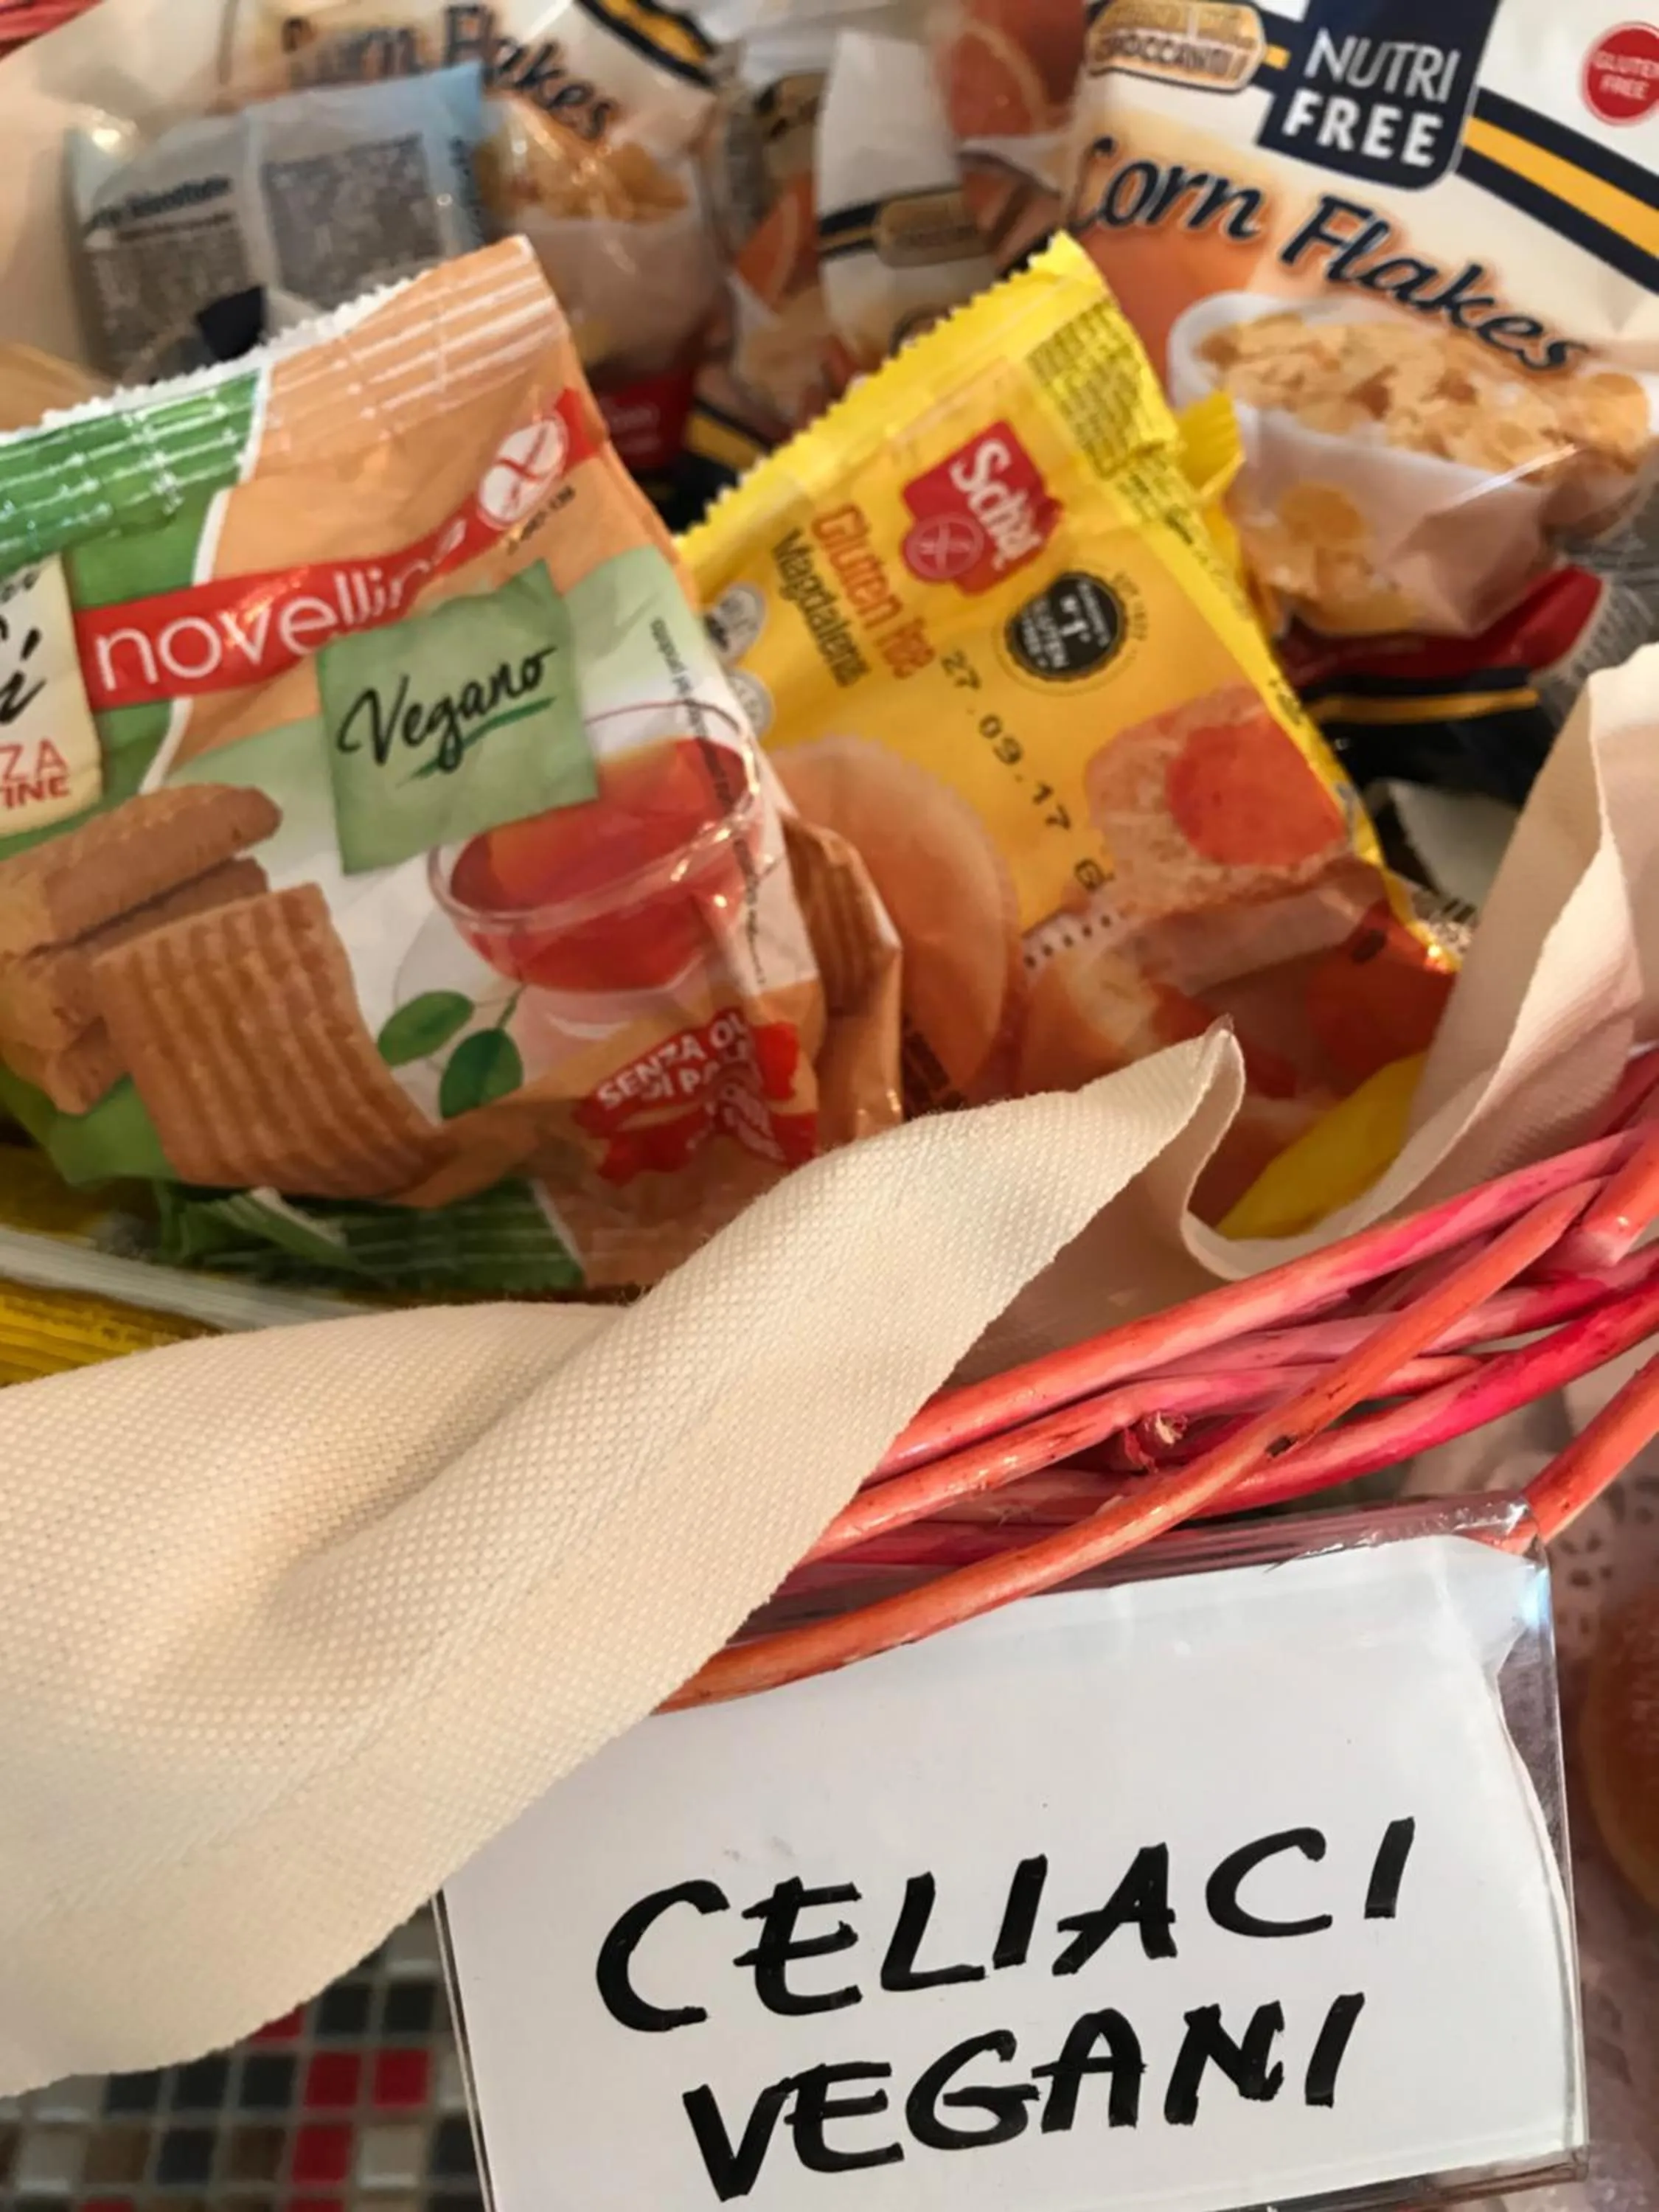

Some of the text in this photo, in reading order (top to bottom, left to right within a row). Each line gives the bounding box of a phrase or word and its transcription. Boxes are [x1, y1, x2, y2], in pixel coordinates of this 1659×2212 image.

[1304, 27, 1461, 104] NUTRI
[1593, 50, 1659, 78] GLUTE
[1281, 89, 1444, 168] FREE
[1279, 195, 1590, 372] Flakes
[812, 503, 903, 630] Gluten
[337, 647, 556, 772] Vegano
[0, 776, 70, 810] INE
[597, 1035, 706, 1108] SENZA
[596, 1817, 1414, 2031] CELIACI
[682, 1993, 1364, 2202] VEGANI
